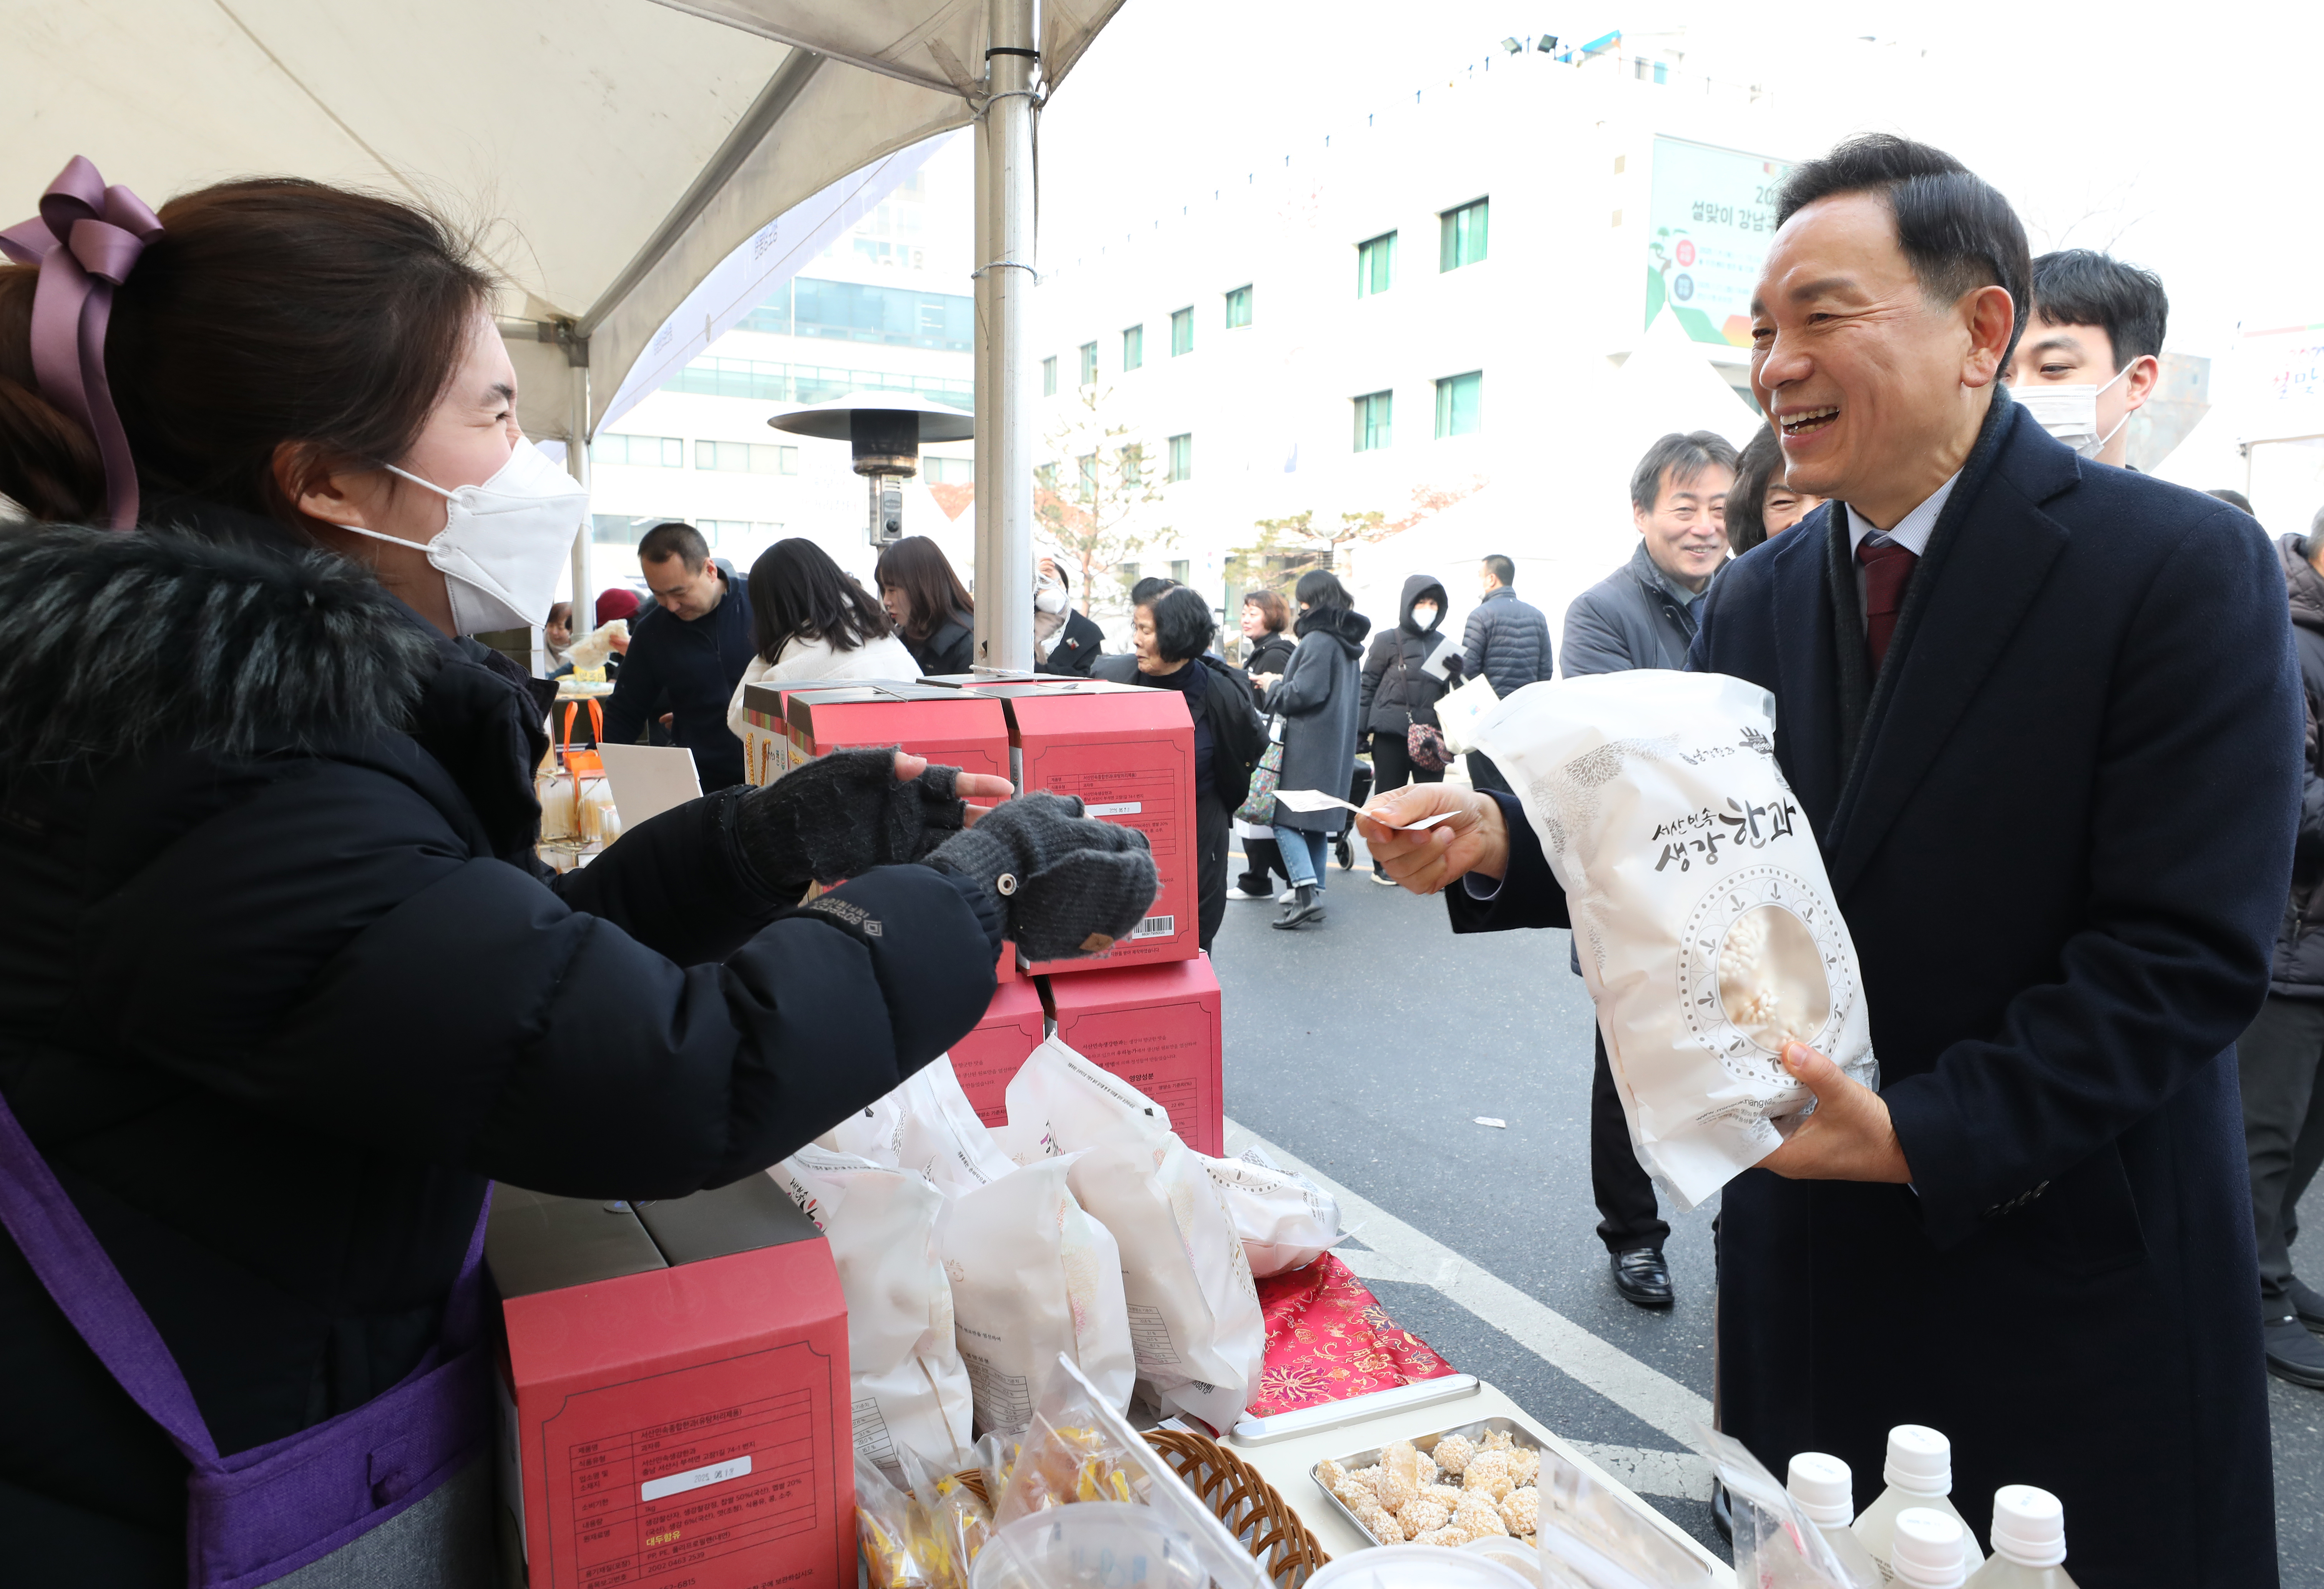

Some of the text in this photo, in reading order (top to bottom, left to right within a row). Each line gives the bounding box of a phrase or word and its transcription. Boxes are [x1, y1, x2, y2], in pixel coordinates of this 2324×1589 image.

[1756, 186, 1773, 204] 20
[1692, 200, 1734, 226] 설맞이
[2269, 368, 2323, 400] 설맞
[1652, 808, 1717, 841] 서산민속
[1655, 797, 1796, 872] 생강 한과
[1129, 1073, 1154, 1082] 영양성분
[578, 1444, 598, 1454] 제품명
[641, 1441, 661, 1452] 과자류
[579, 1455, 606, 1467] 식품유형
[642, 1448, 696, 1467] 서산민속생강한과
[658, 1462, 678, 1472] 서산시
[681, 1456, 699, 1468] 부석면
[727, 1446, 741, 1454] 74-1
[742, 1441, 755, 1450] 번지
[580, 1481, 600, 1491] 소재지
[694, 1473, 710, 1483] 2025
[787, 1479, 802, 1487] 20%
[582, 1498, 608, 1511] 소비기한
[669, 1521, 682, 1530] 생강
[646, 1530, 681, 1546] 대두함유
[647, 1551, 705, 1573] 2002 0463 2539
[775, 1568, 814, 1585] 보관하십시오
